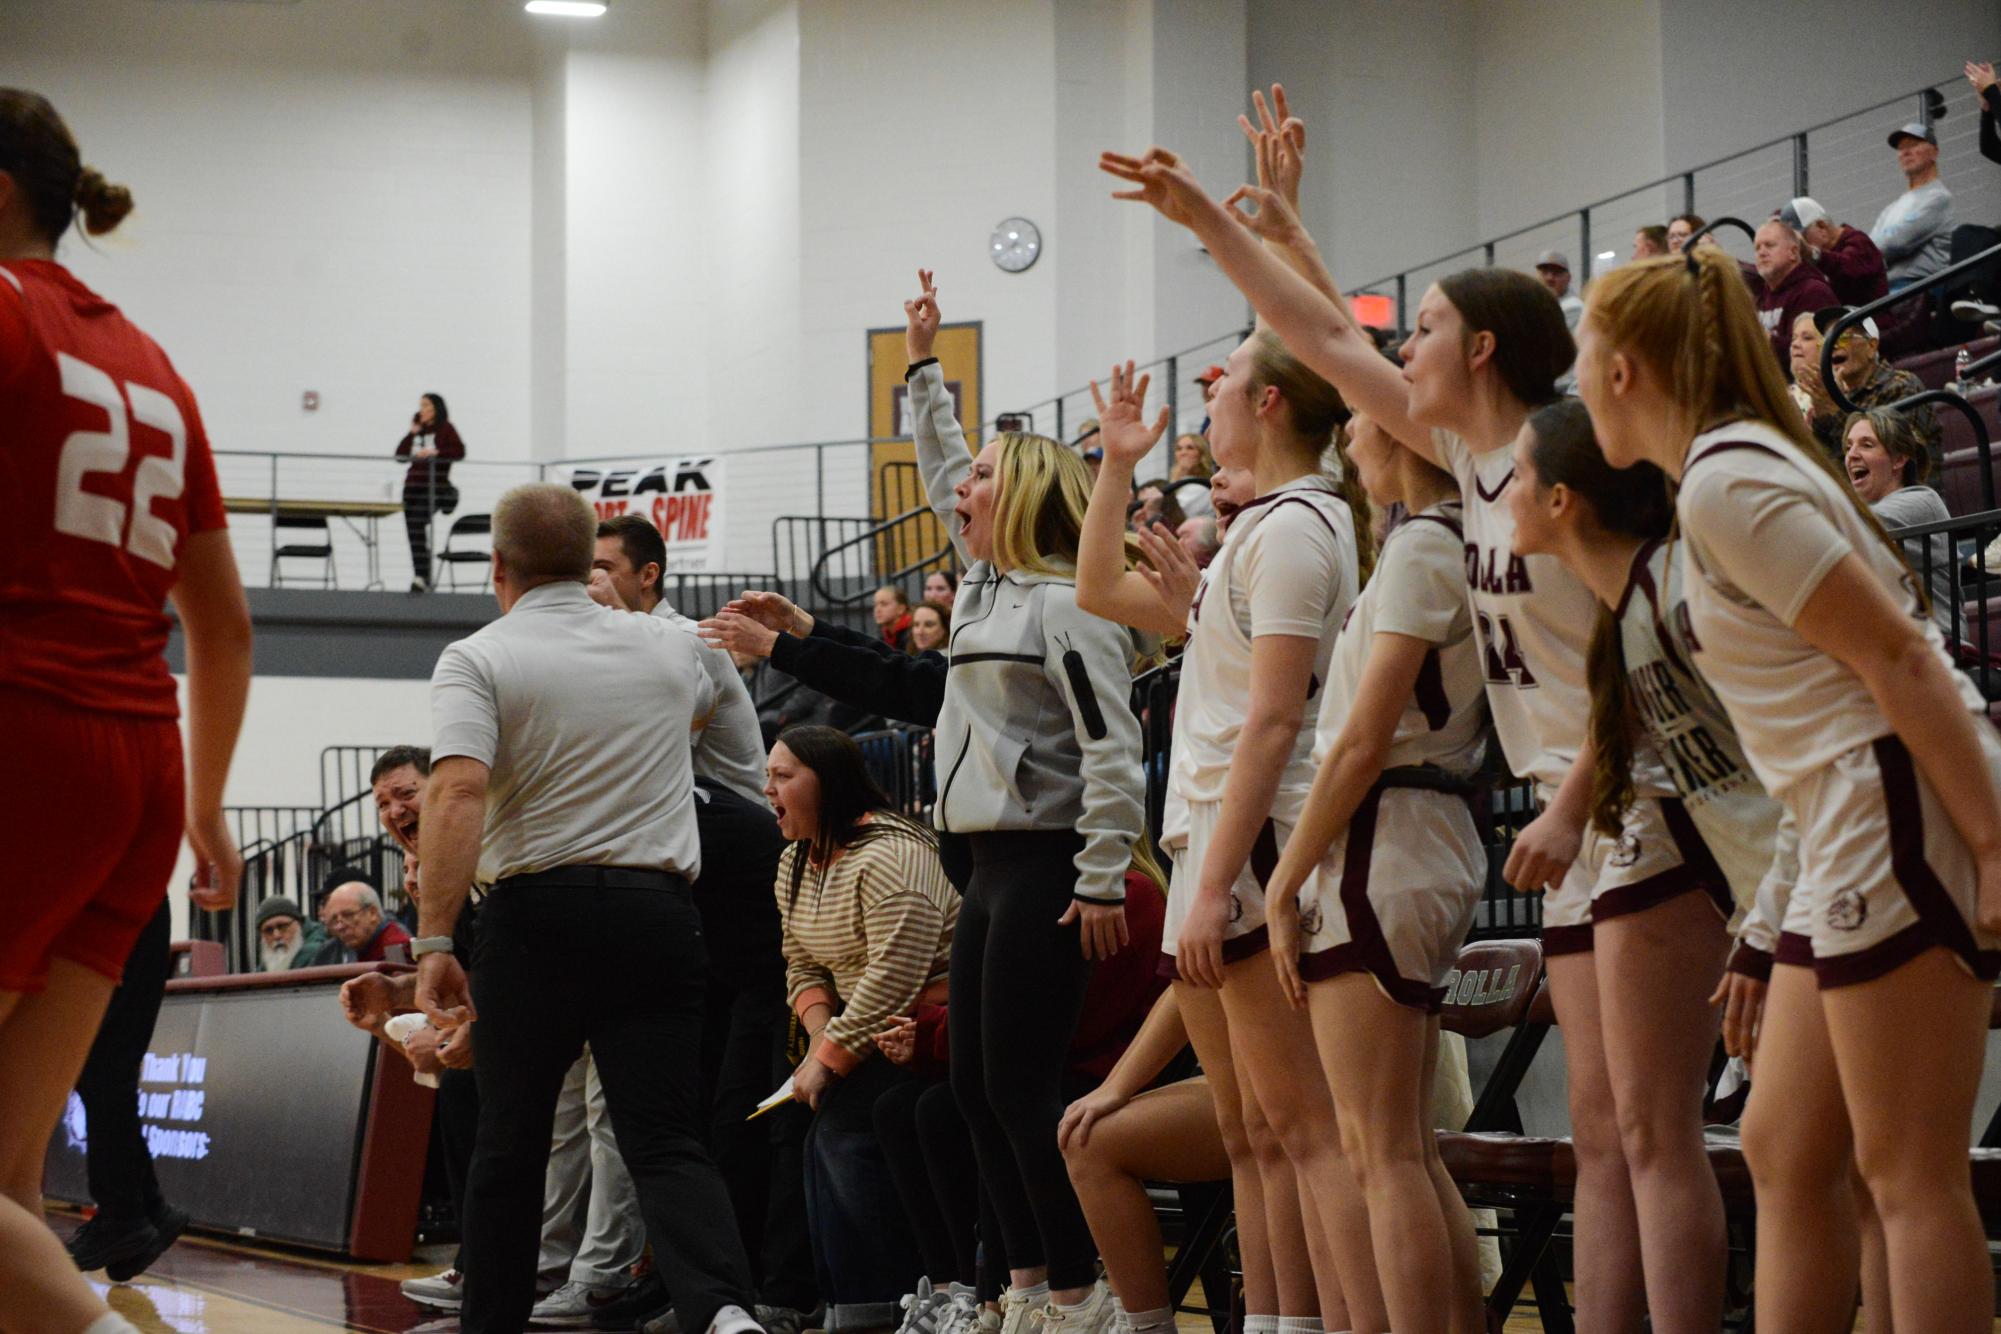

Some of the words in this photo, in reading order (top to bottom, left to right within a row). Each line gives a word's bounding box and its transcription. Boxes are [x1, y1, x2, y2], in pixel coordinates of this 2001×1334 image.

[54, 350, 187, 571] 22
[572, 459, 714, 497] PEAK
[652, 494, 713, 541] SPINE
[1464, 543, 1533, 594] OLLA
[1442, 964, 1521, 1006] ROLLA
